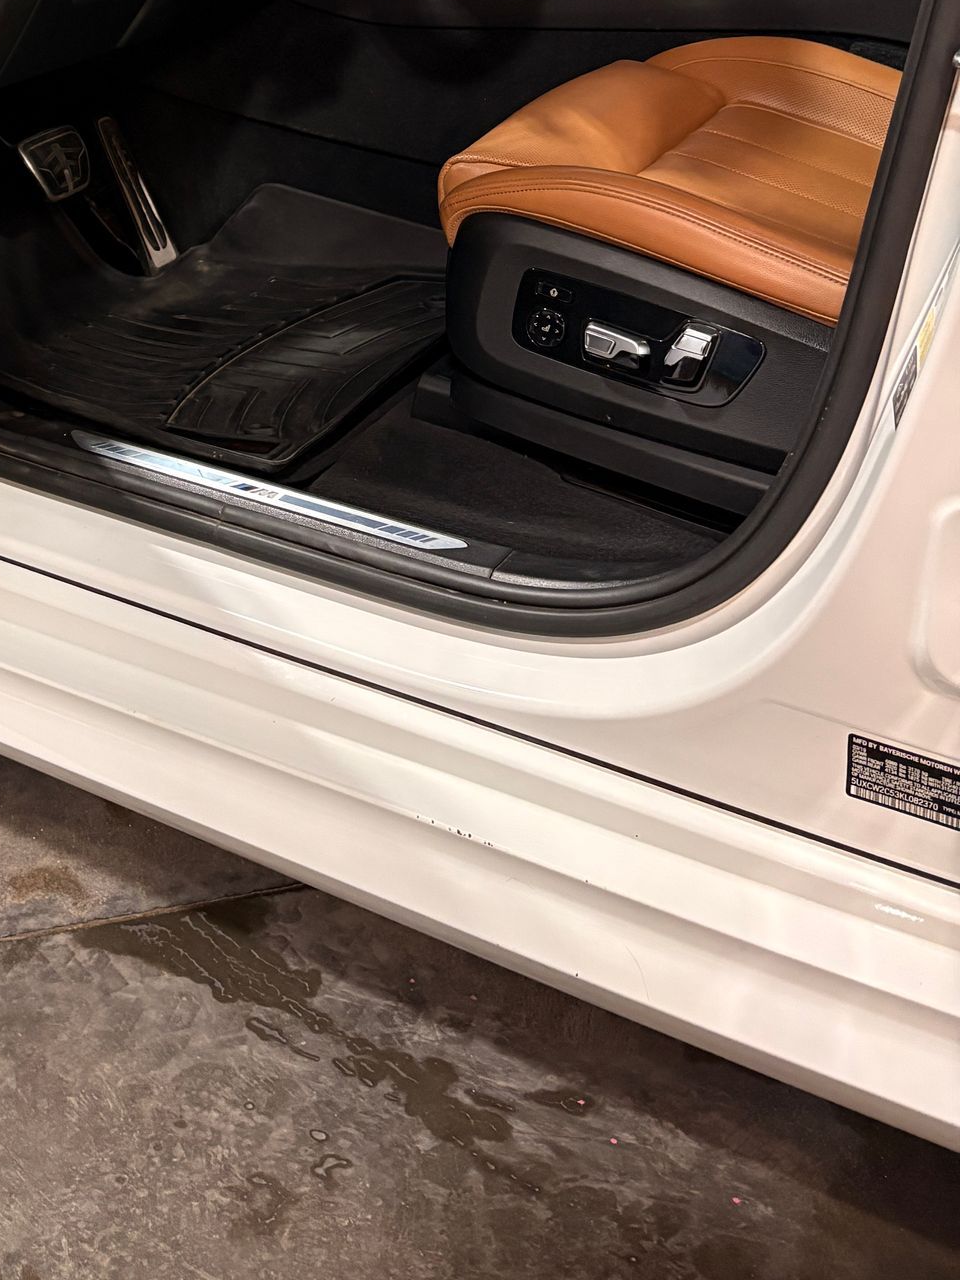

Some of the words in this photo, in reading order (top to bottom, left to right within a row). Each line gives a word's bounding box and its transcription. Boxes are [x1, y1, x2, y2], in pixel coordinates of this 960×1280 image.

[852, 736, 867, 746] MFD
[868, 741, 877, 749] BY
[879, 745, 919, 762] BAYERISCHE
[919, 758, 952, 773] MOTOREN
